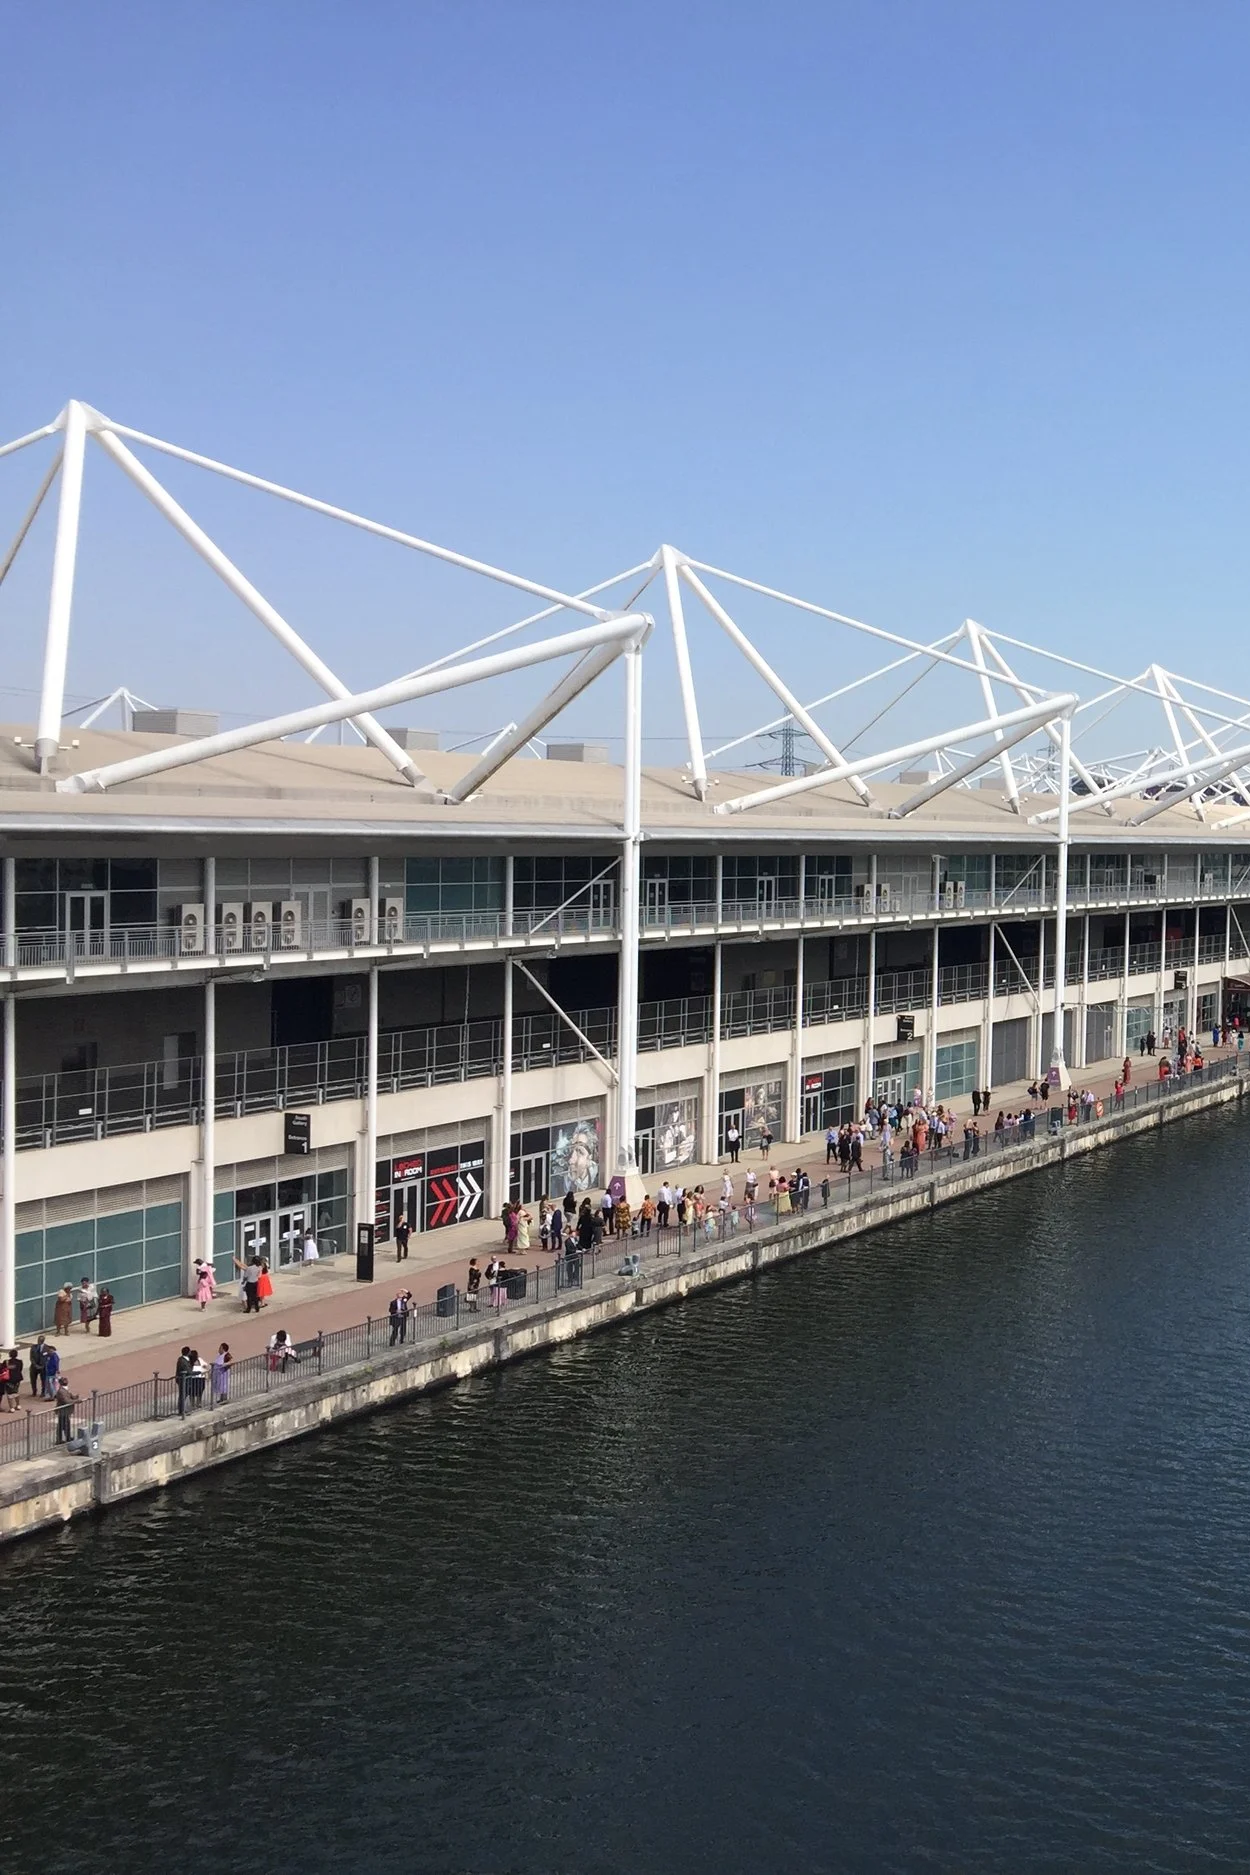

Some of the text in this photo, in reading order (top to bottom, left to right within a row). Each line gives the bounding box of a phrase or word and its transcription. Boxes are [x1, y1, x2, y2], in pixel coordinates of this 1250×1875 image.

[907, 1032, 913, 1040] 2
[301, 1141, 308, 1154] 1
[92, 1441, 98, 1450] 2
